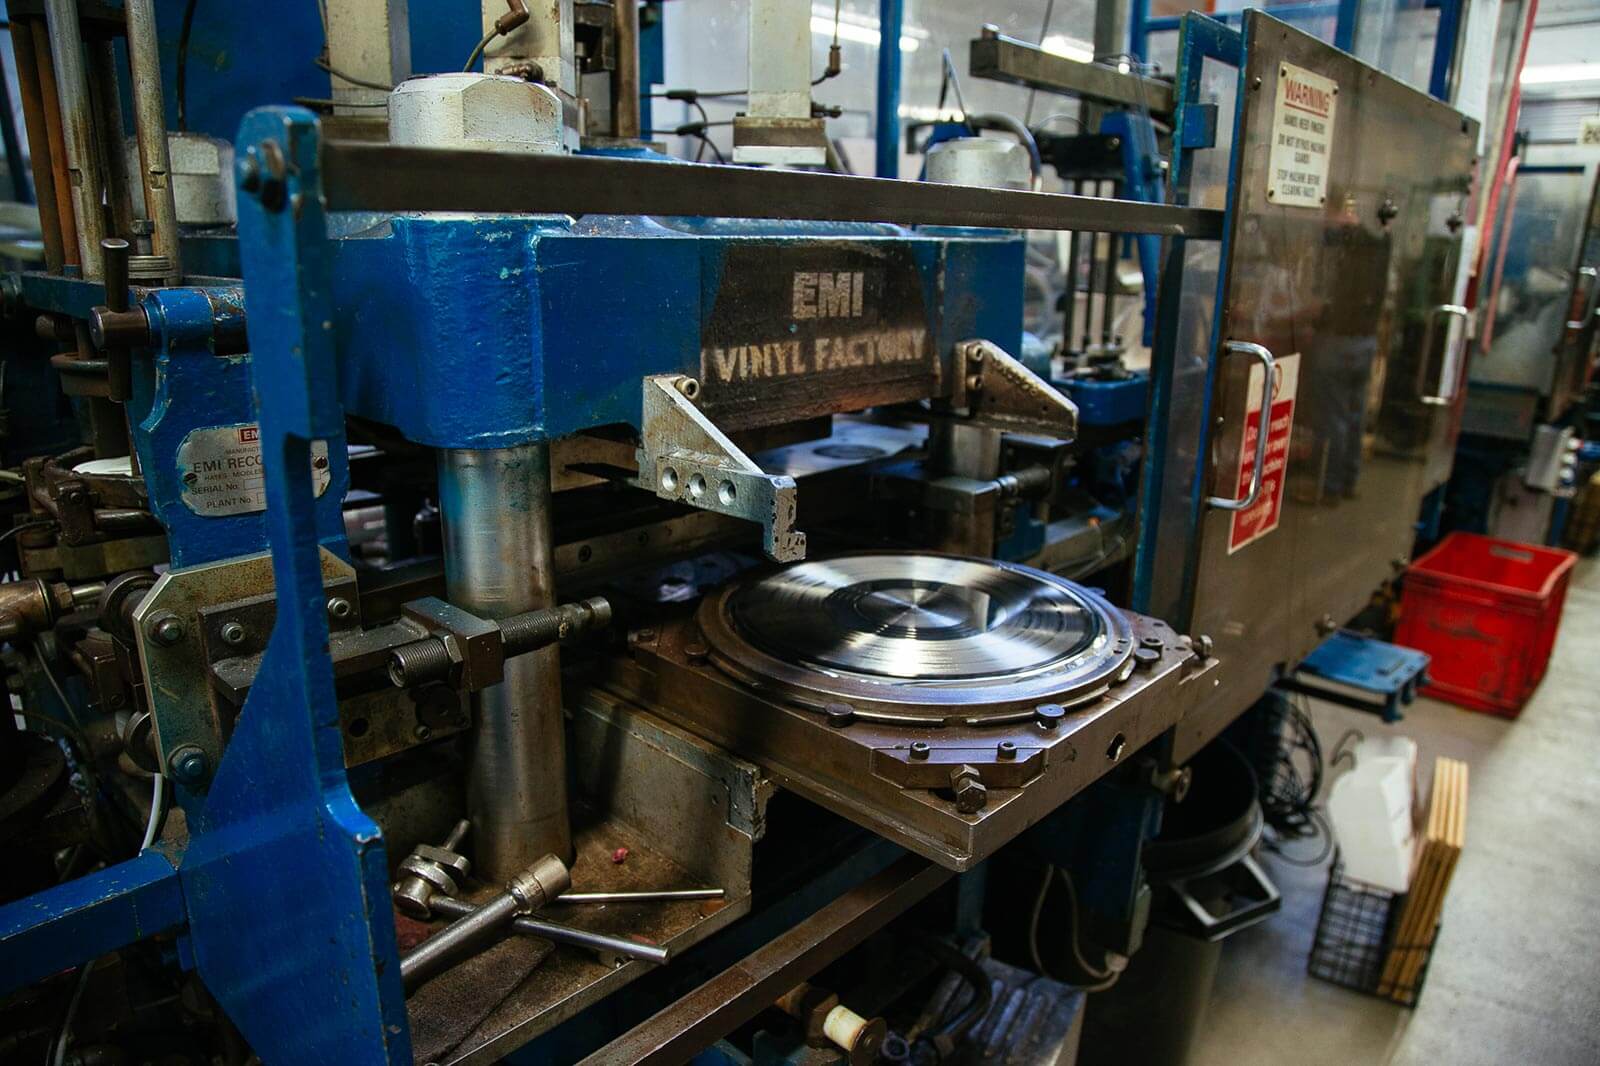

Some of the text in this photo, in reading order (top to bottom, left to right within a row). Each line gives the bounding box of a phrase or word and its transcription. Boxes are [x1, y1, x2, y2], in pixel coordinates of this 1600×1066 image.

[1285, 79, 1330, 112] WARNING
[792, 272, 865, 319] EMI
[715, 328, 927, 383] VINYL FACTORY
[243, 430, 259, 440] EM
[193, 455, 263, 473] EMI RECO
[191, 485, 224, 495] SERIAL
[206, 498, 237, 509] PLANT
